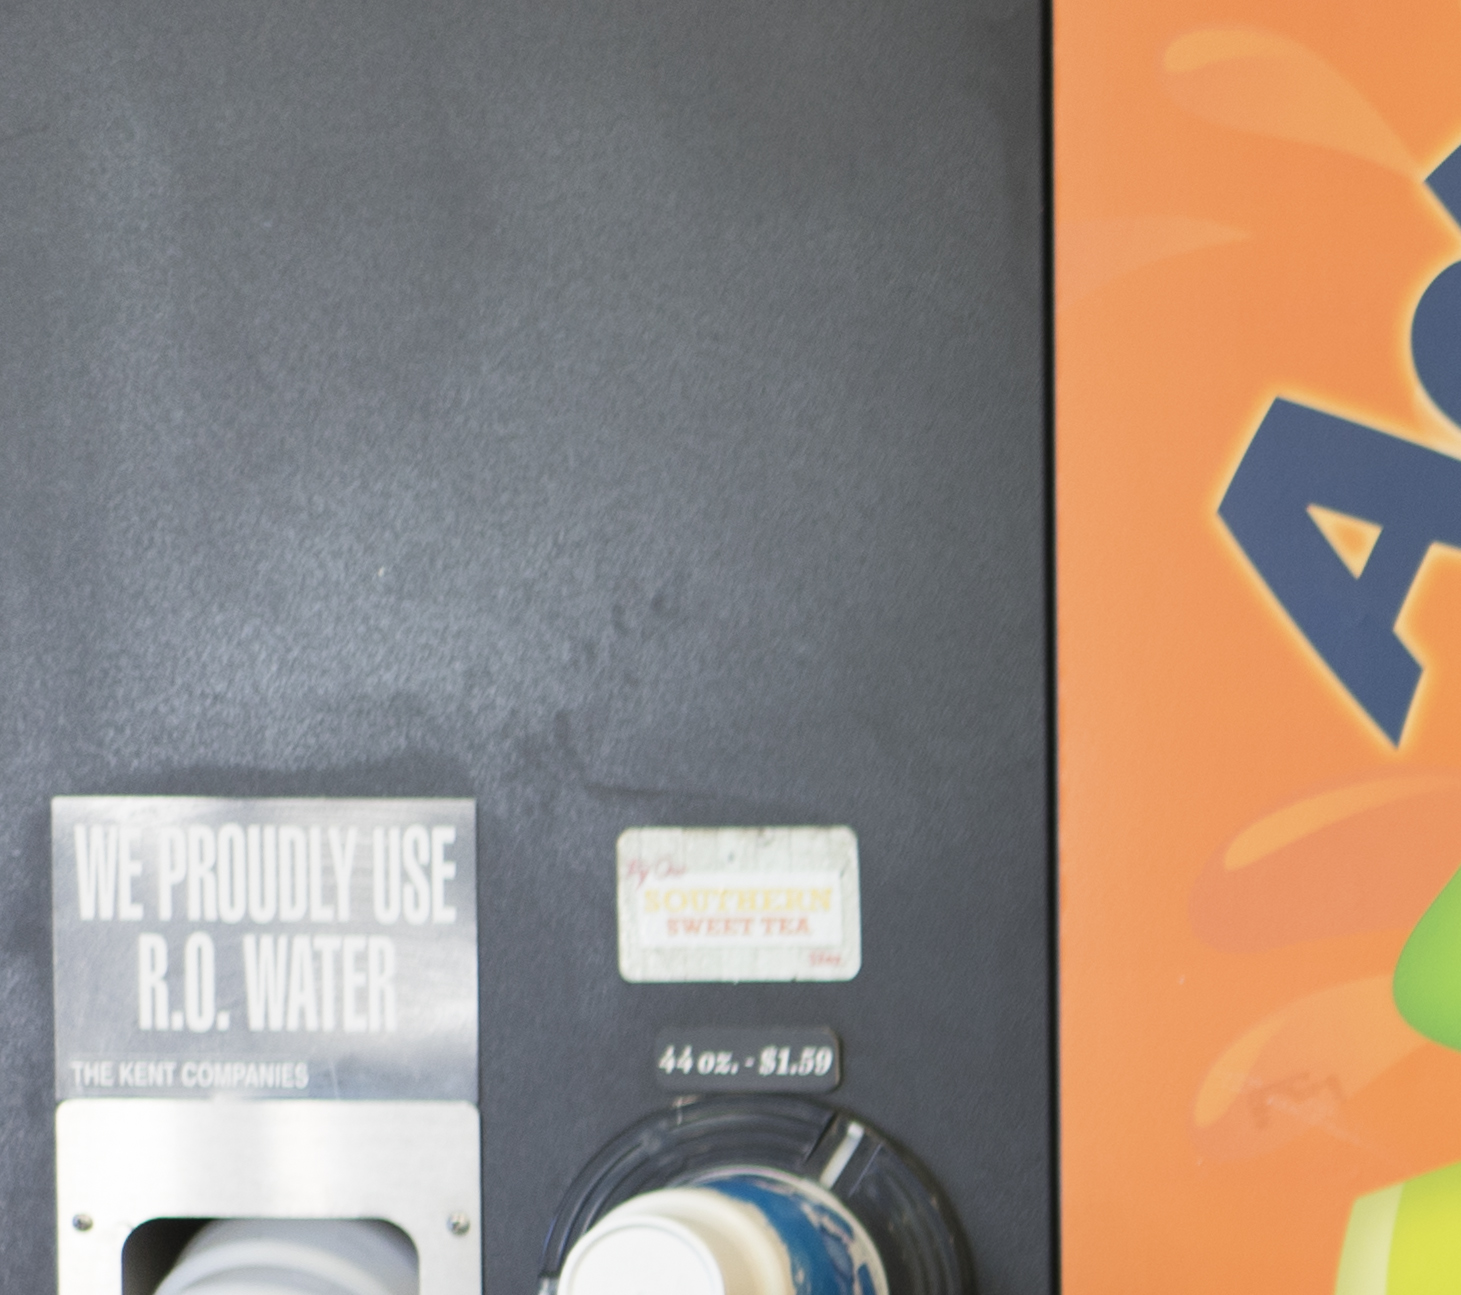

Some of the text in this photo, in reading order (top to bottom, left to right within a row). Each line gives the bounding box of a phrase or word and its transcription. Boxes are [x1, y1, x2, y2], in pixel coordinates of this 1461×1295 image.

[74, 824, 456, 924] WE PROUDLY USE
[644, 887, 834, 913] SOUTHERN
[666, 915, 812, 937] SWEET TEA
[137, 933, 397, 1034] R.O. WATER
[72, 1061, 309, 1090] THE KENT COMPANIES
[658, 1044, 694, 1075] 44
[697, 1051, 739, 1076] oz.
[757, 1044, 834, 1077] $1.59
